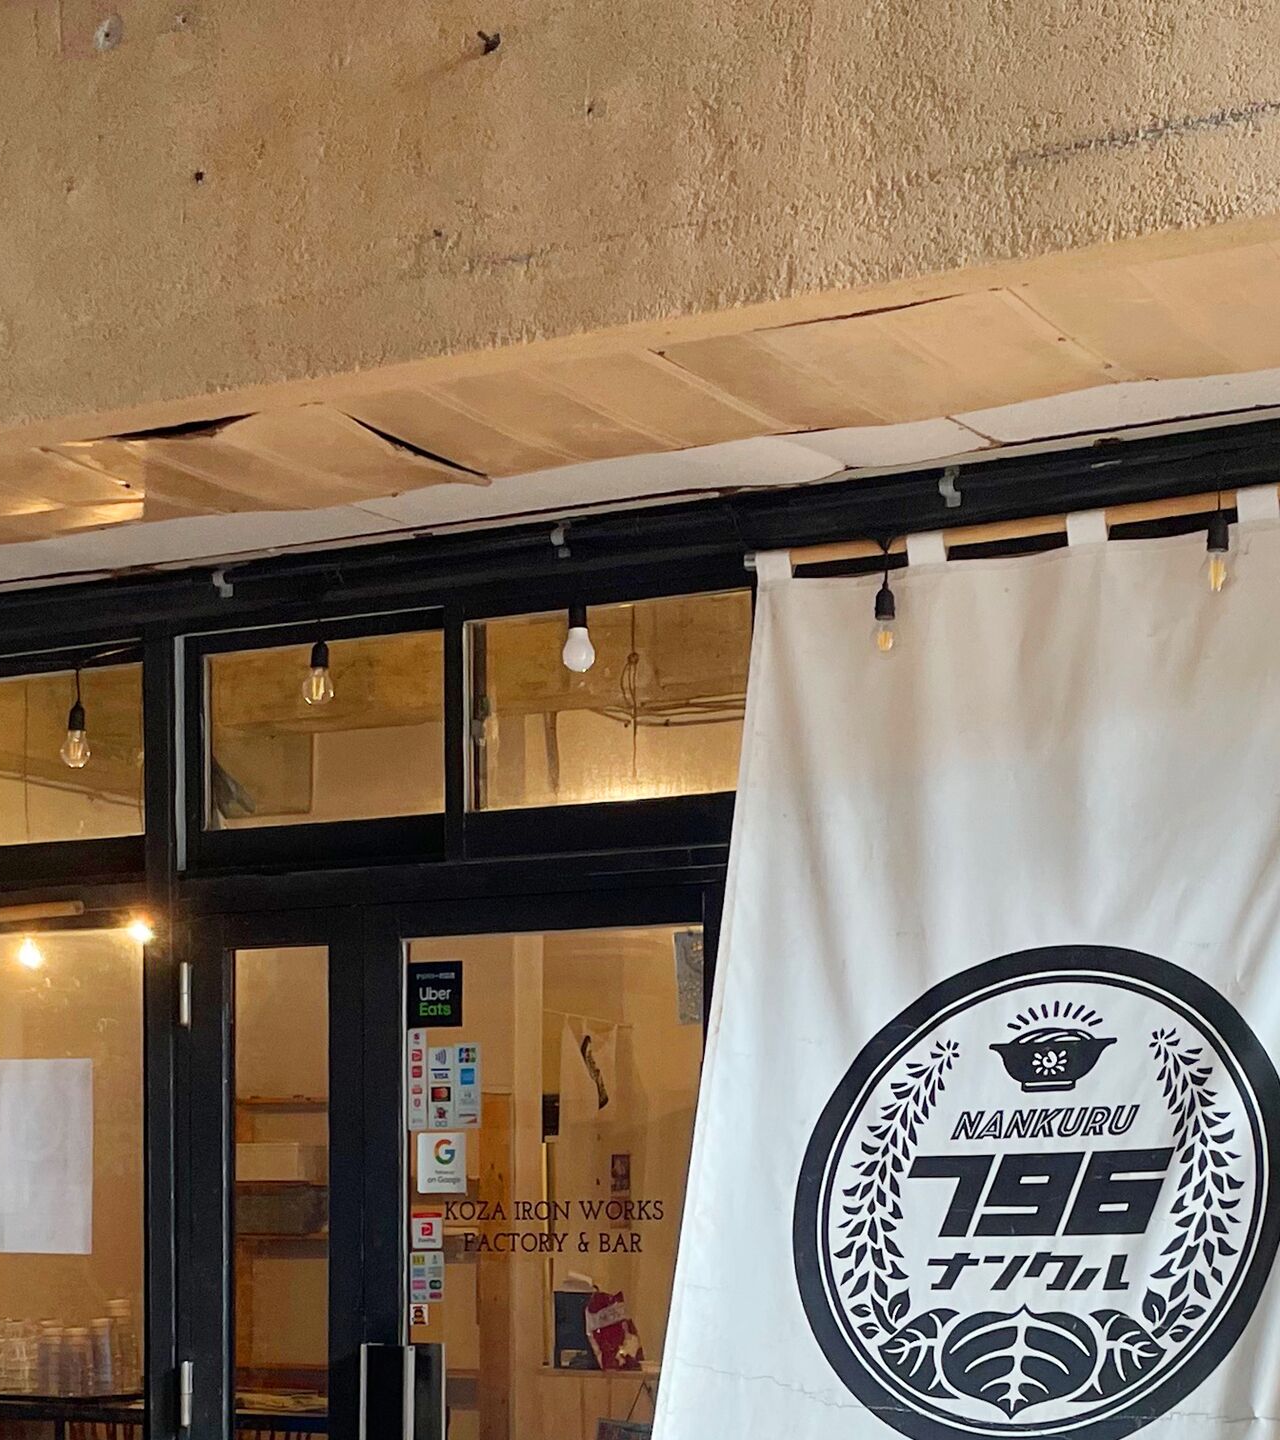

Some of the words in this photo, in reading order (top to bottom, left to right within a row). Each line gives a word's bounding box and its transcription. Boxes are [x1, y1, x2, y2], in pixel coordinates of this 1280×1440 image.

[418, 986, 452, 1001] Uber
[419, 1001, 452, 1017] Eats
[950, 1103, 1141, 1140] NANKURU
[908, 1146, 1176, 1238] 796
[444, 1200, 507, 1221] KOZA
[514, 1200, 570, 1221] IRON
[578, 1200, 664, 1221] WORKS
[464, 1232, 569, 1252] FACTORY
[577, 1231, 590, 1252] &
[598, 1232, 643, 1253] BAR
[927, 1252, 1131, 1292] ナンクル
